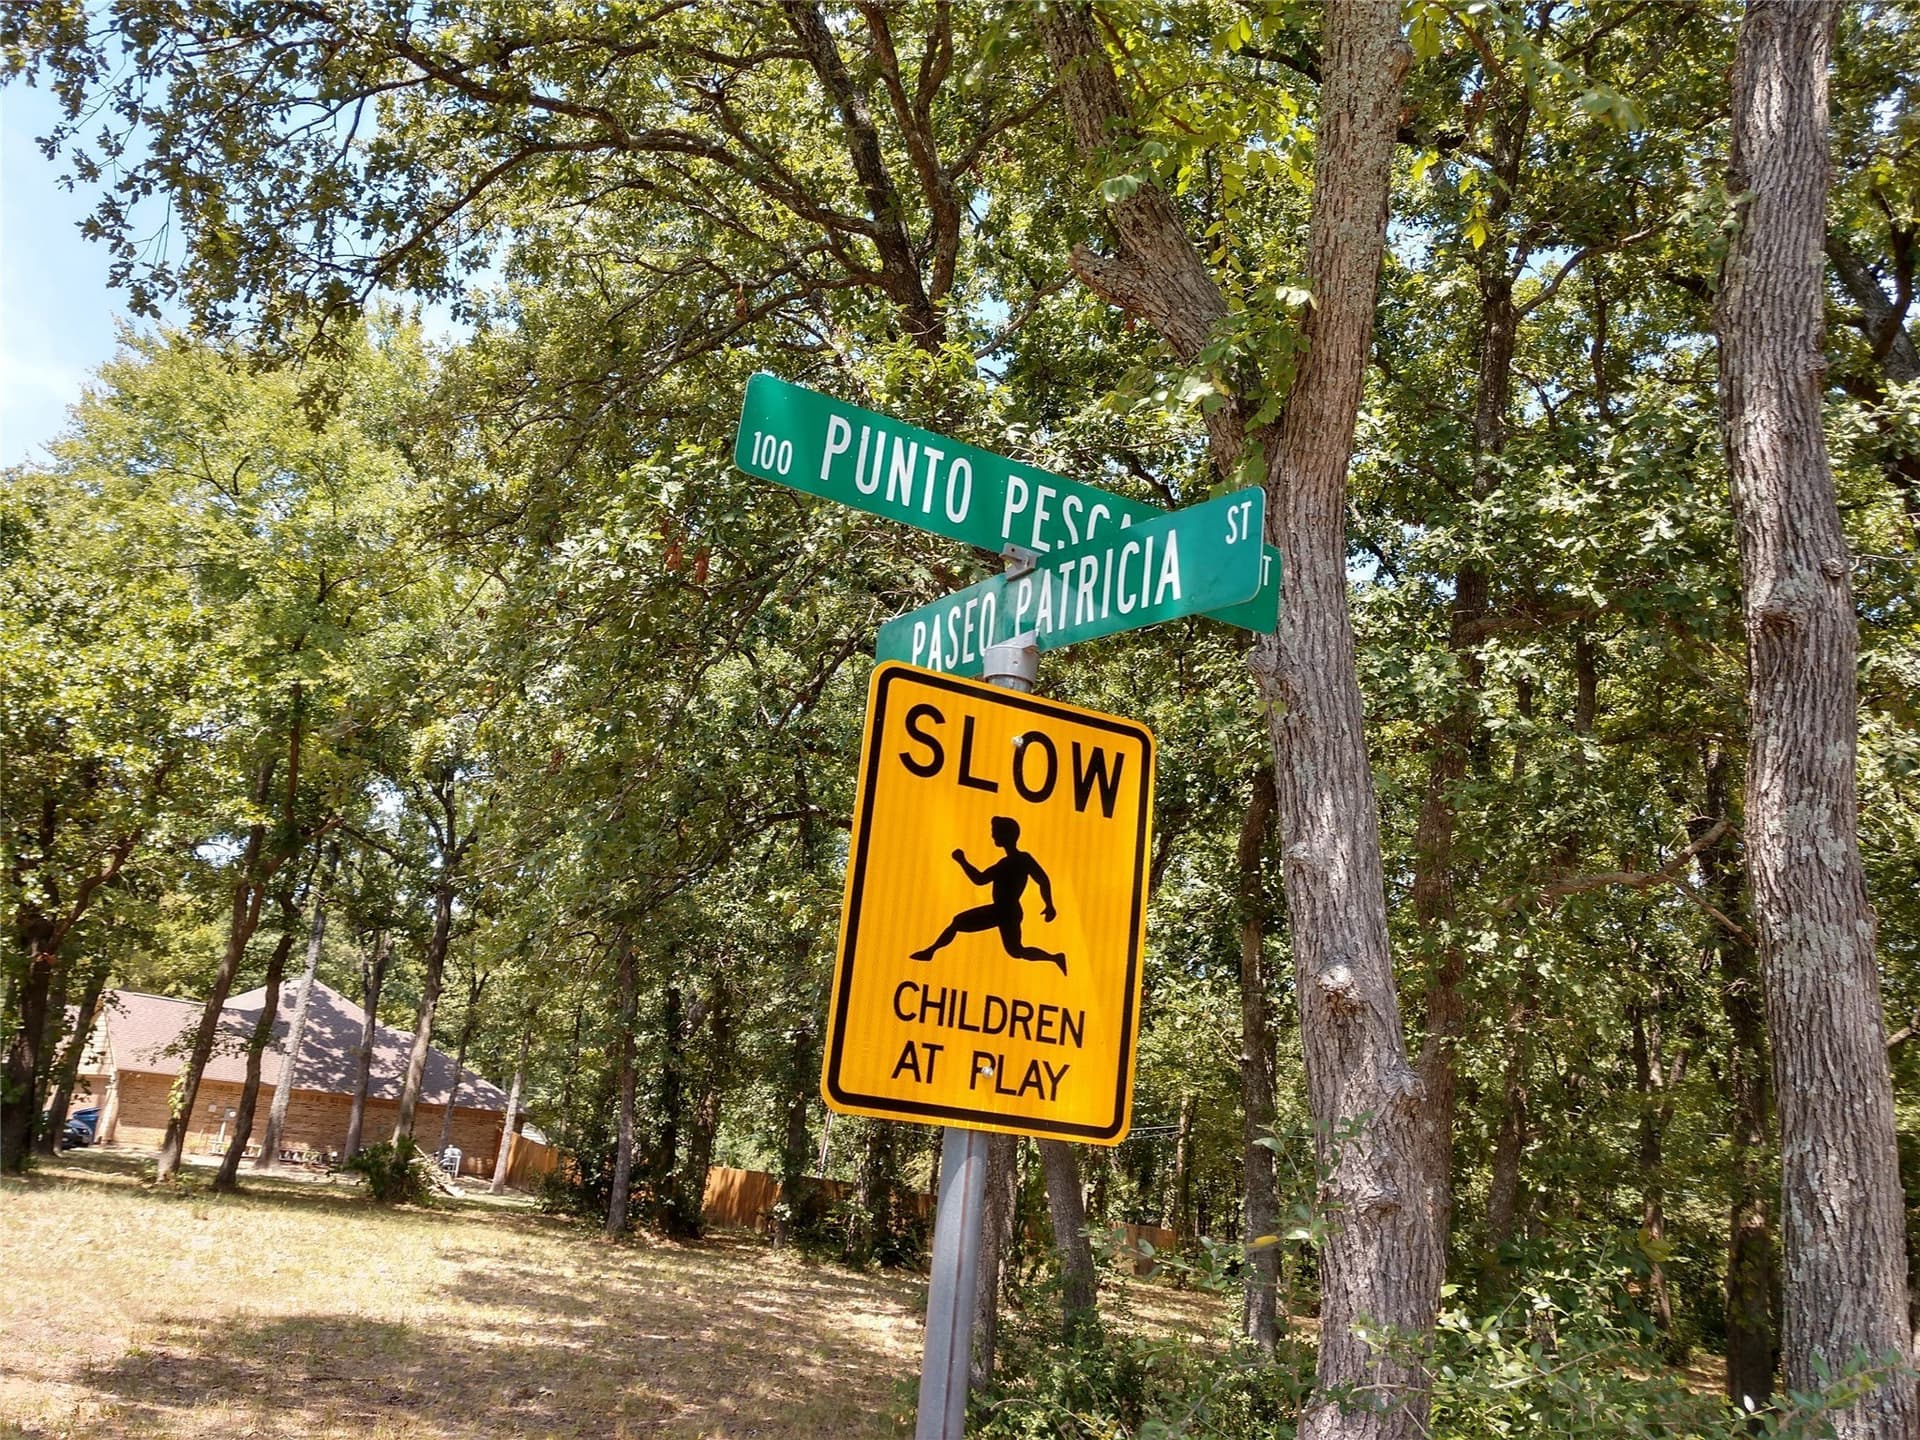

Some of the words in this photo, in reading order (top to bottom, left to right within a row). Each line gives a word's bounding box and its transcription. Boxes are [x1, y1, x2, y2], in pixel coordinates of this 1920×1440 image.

[751, 432, 792, 475] 100
[820, 414, 972, 523] PUNTO
[1001, 475, 1132, 552] PESC
[912, 592, 996, 672] PASEO
[1015, 529, 1182, 637] PATRICIA
[1225, 501, 1252, 544] ST
[899, 704, 1124, 818] SLOW
[892, 1041, 943, 1084] AT
[970, 1052, 1070, 1101] PLAY
[893, 982, 1085, 1048] CHILDREN
